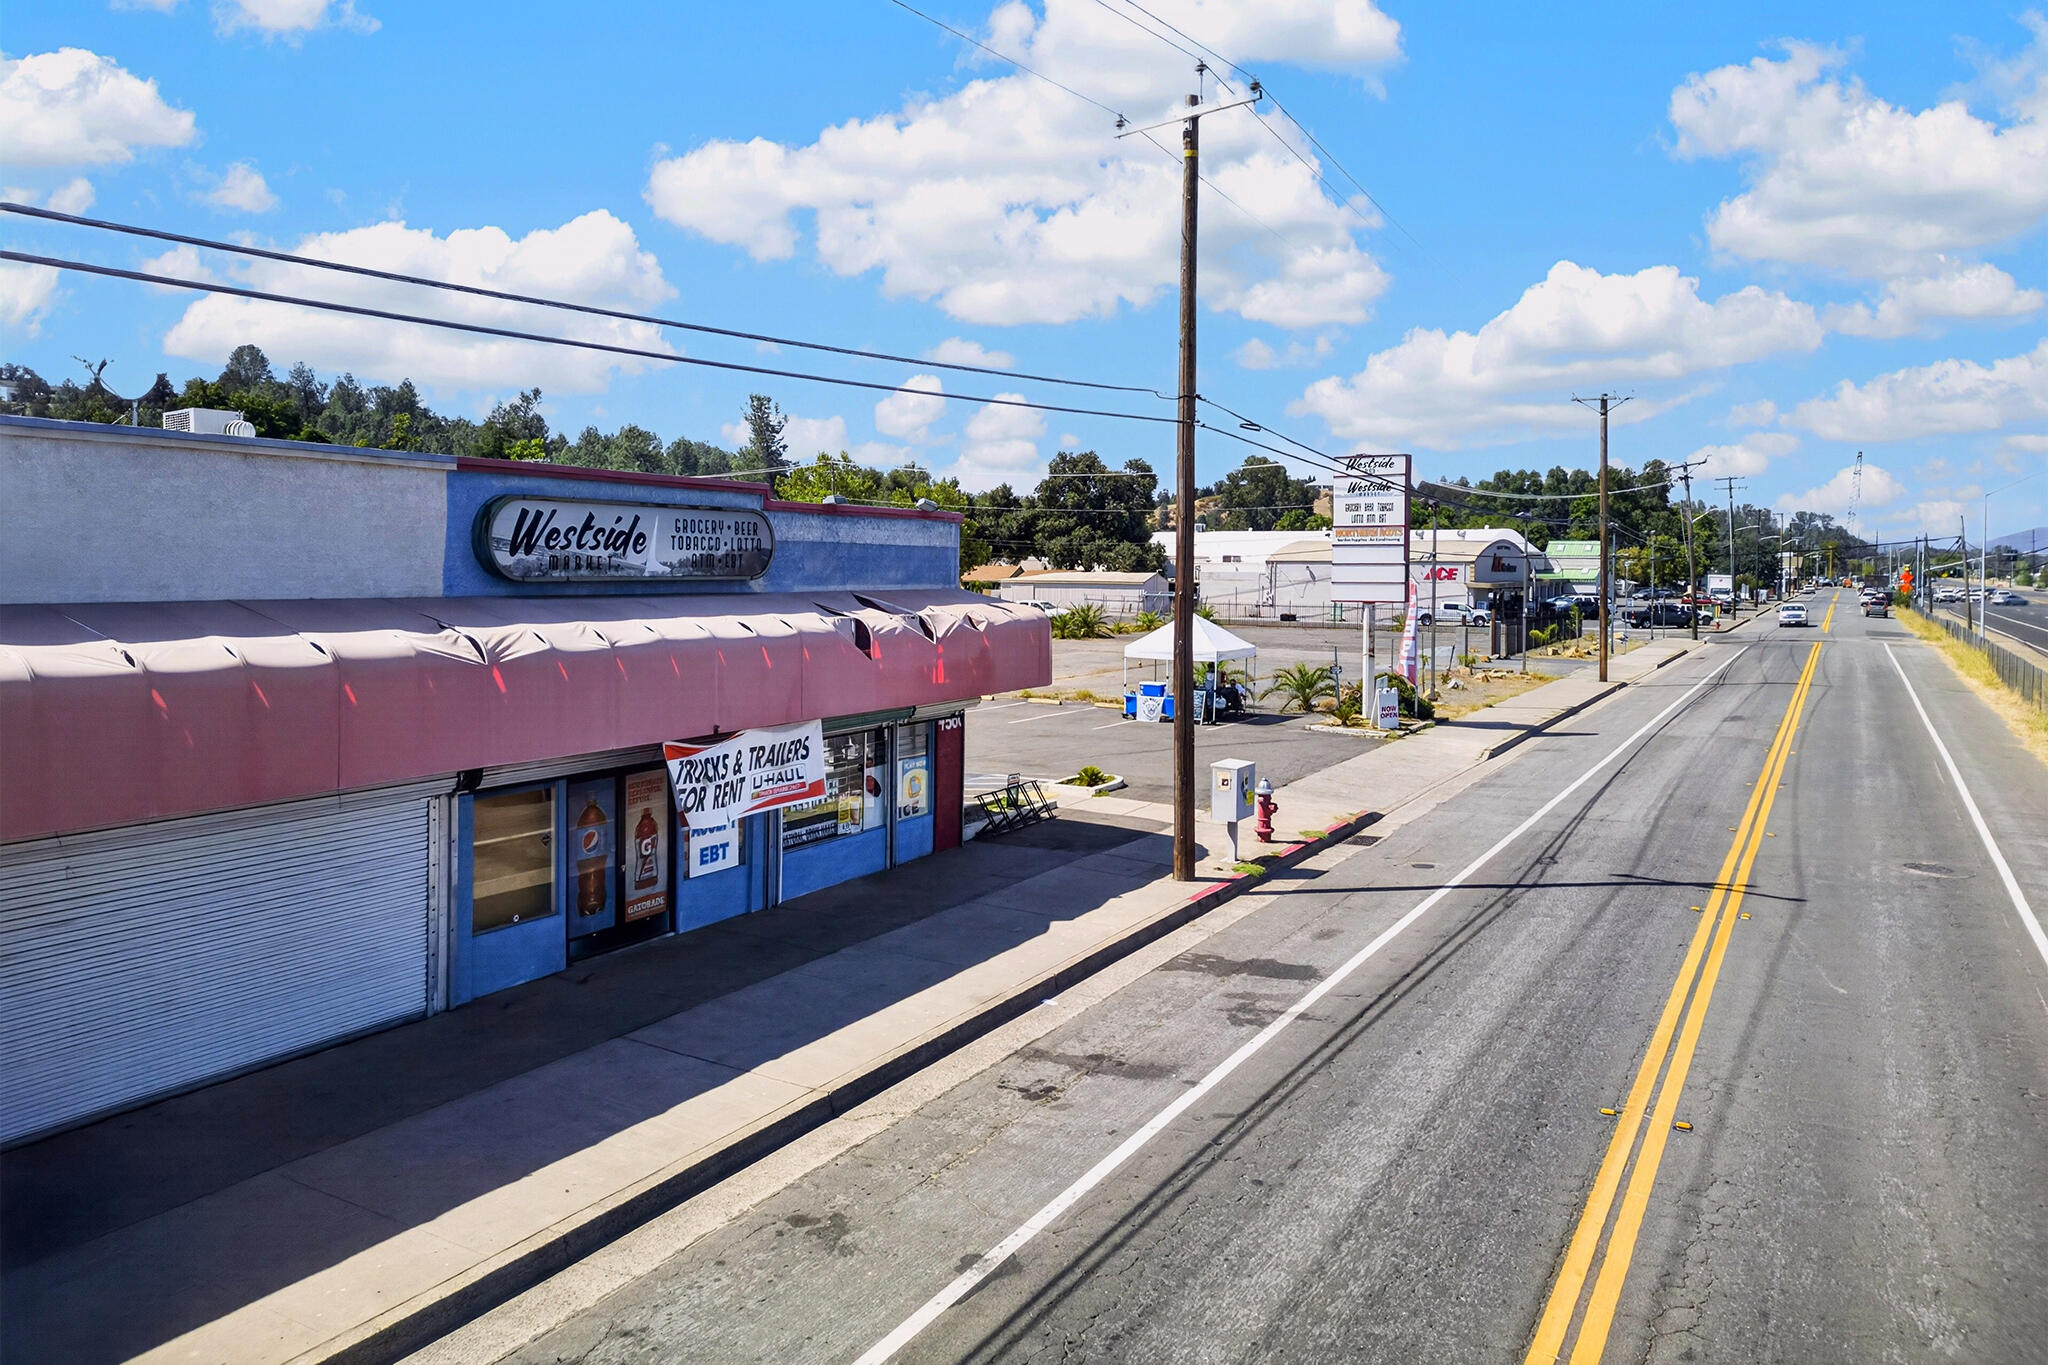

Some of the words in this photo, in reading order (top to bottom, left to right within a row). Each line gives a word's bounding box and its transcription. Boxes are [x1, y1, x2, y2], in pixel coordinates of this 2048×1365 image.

[1346, 457, 1394, 471] Westside
[1348, 481, 1392, 493] Westside
[509, 507, 647, 559] Westside
[674, 519, 724, 535] GROCERY
[734, 521, 759, 537] BEER
[671, 535, 721, 551] TOBACCO
[730, 537, 762, 552] LOTTO
[548, 555, 613, 572] MARKET
[691, 554, 715, 569] ATM
[724, 554, 743, 569] EBT
[1424, 567, 1458, 581] ACE
[1382, 705, 1396, 713] NOW
[676, 754, 729, 786] TRUCKS
[733, 750, 743, 776] &
[749, 736, 809, 771] TRAILERS
[678, 785, 706, 814] FOR
[713, 777, 746, 810] RENT
[898, 804, 919, 818] ICE
[641, 838, 652, 856] G
[699, 841, 729, 866] EBT
[628, 896, 664, 914] GATORADE
